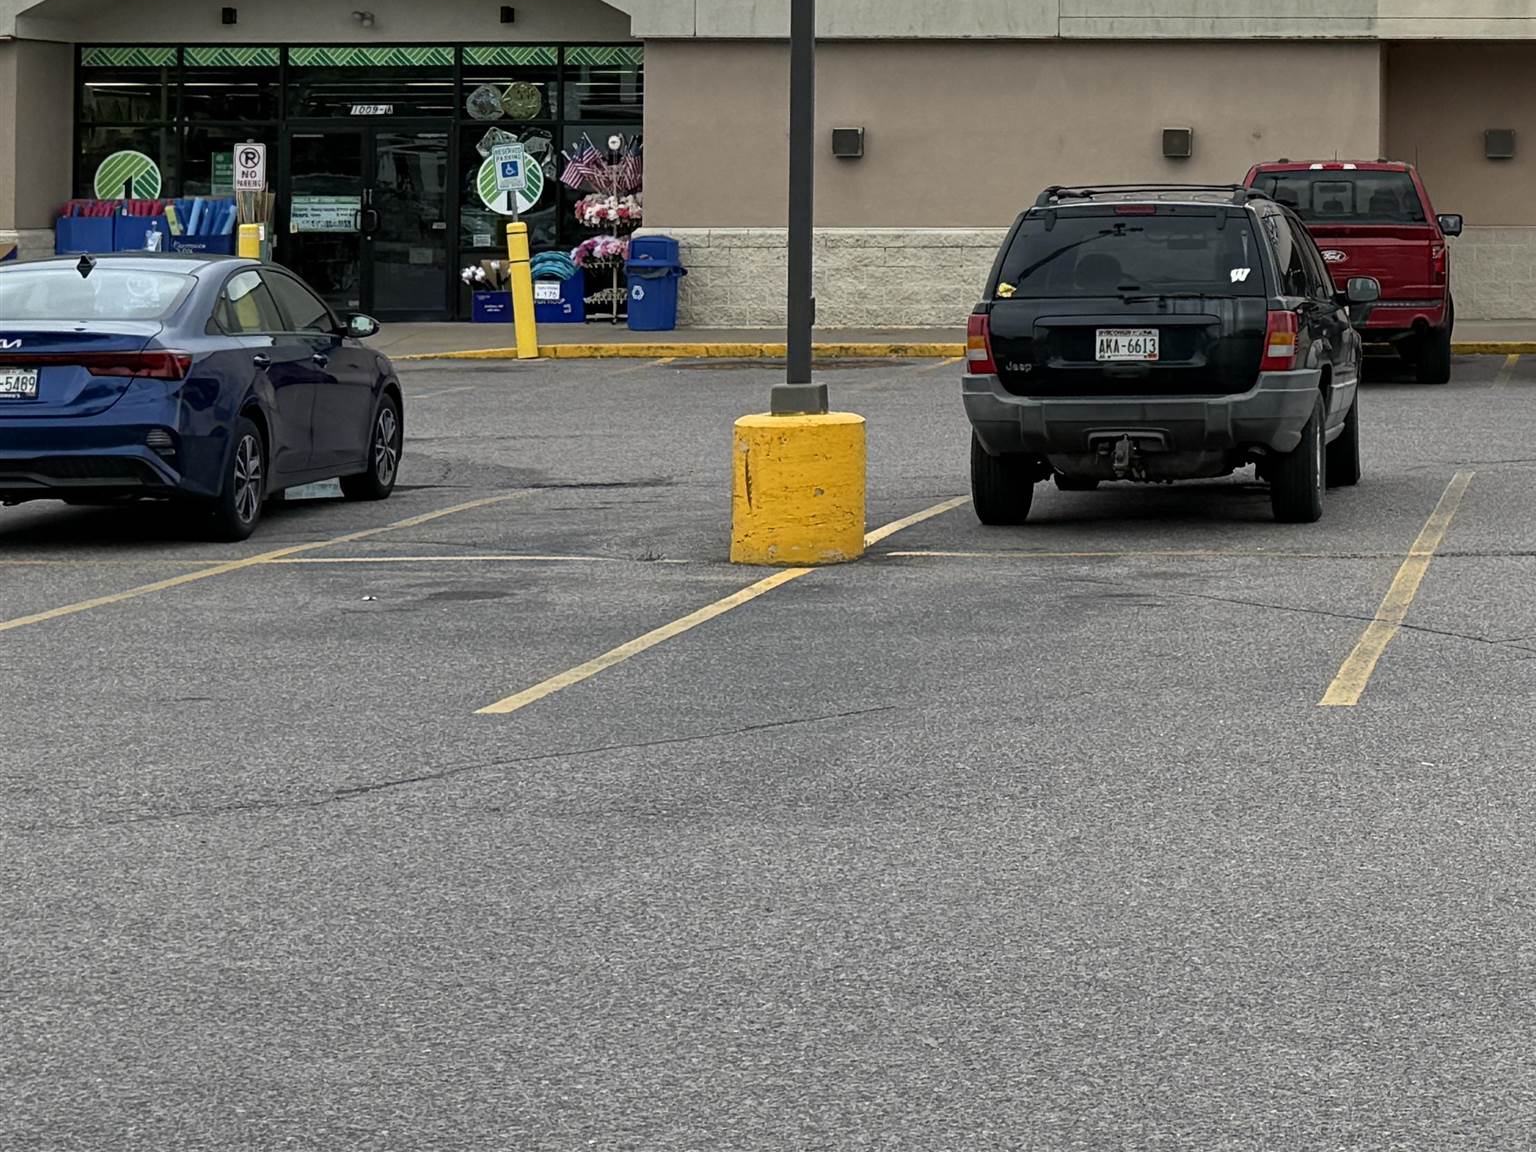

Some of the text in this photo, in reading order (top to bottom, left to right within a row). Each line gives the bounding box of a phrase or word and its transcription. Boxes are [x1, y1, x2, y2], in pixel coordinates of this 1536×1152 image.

[241, 170, 257, 179] NO
[236, 179, 262, 188] PARKING
[1099, 338, 1156, 354] AKA-6613
[1005, 360, 1033, 373] Jeep
